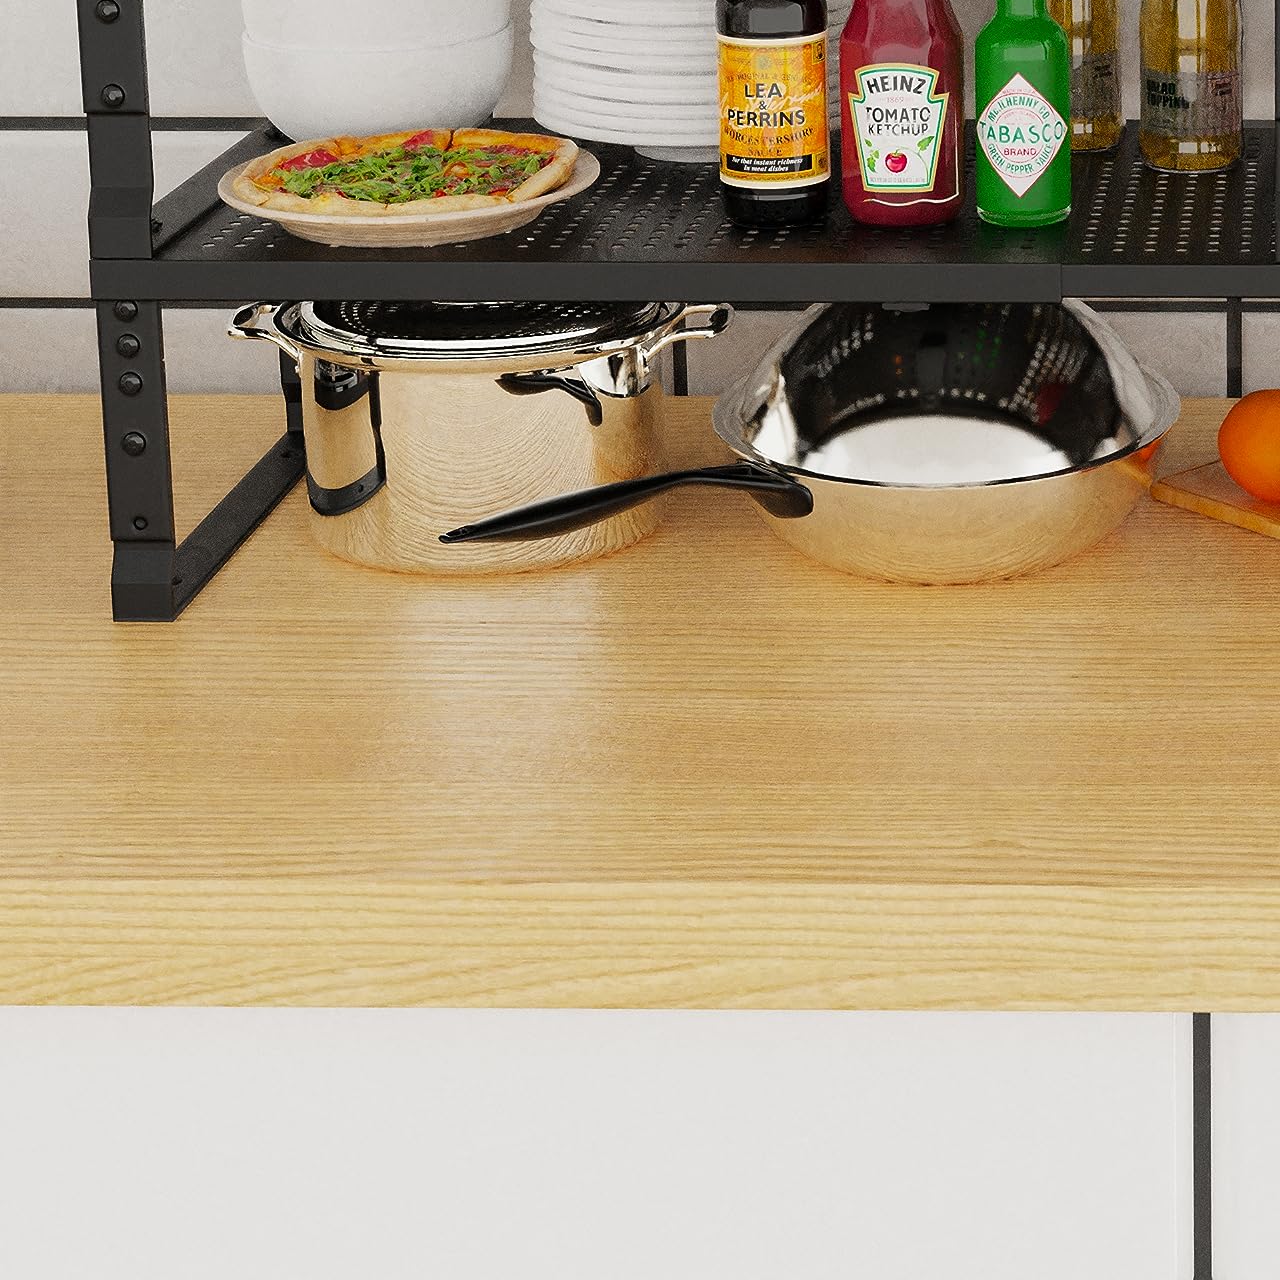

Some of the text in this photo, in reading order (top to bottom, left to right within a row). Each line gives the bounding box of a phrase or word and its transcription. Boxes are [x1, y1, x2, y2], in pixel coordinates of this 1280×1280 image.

[744, 83, 783, 99] LEA
[866, 75, 927, 94] HEINZ
[759, 101, 768, 111] &
[727, 109, 806, 128] PERRINS
[866, 107, 931, 123] TOMATO
[868, 123, 928, 136] KETCHUP
[979, 121, 1063, 144] TABASCO
[988, 144, 1052, 175] GREEN PEPPER SAUCE
[1003, 148, 1037, 156] BRAND
